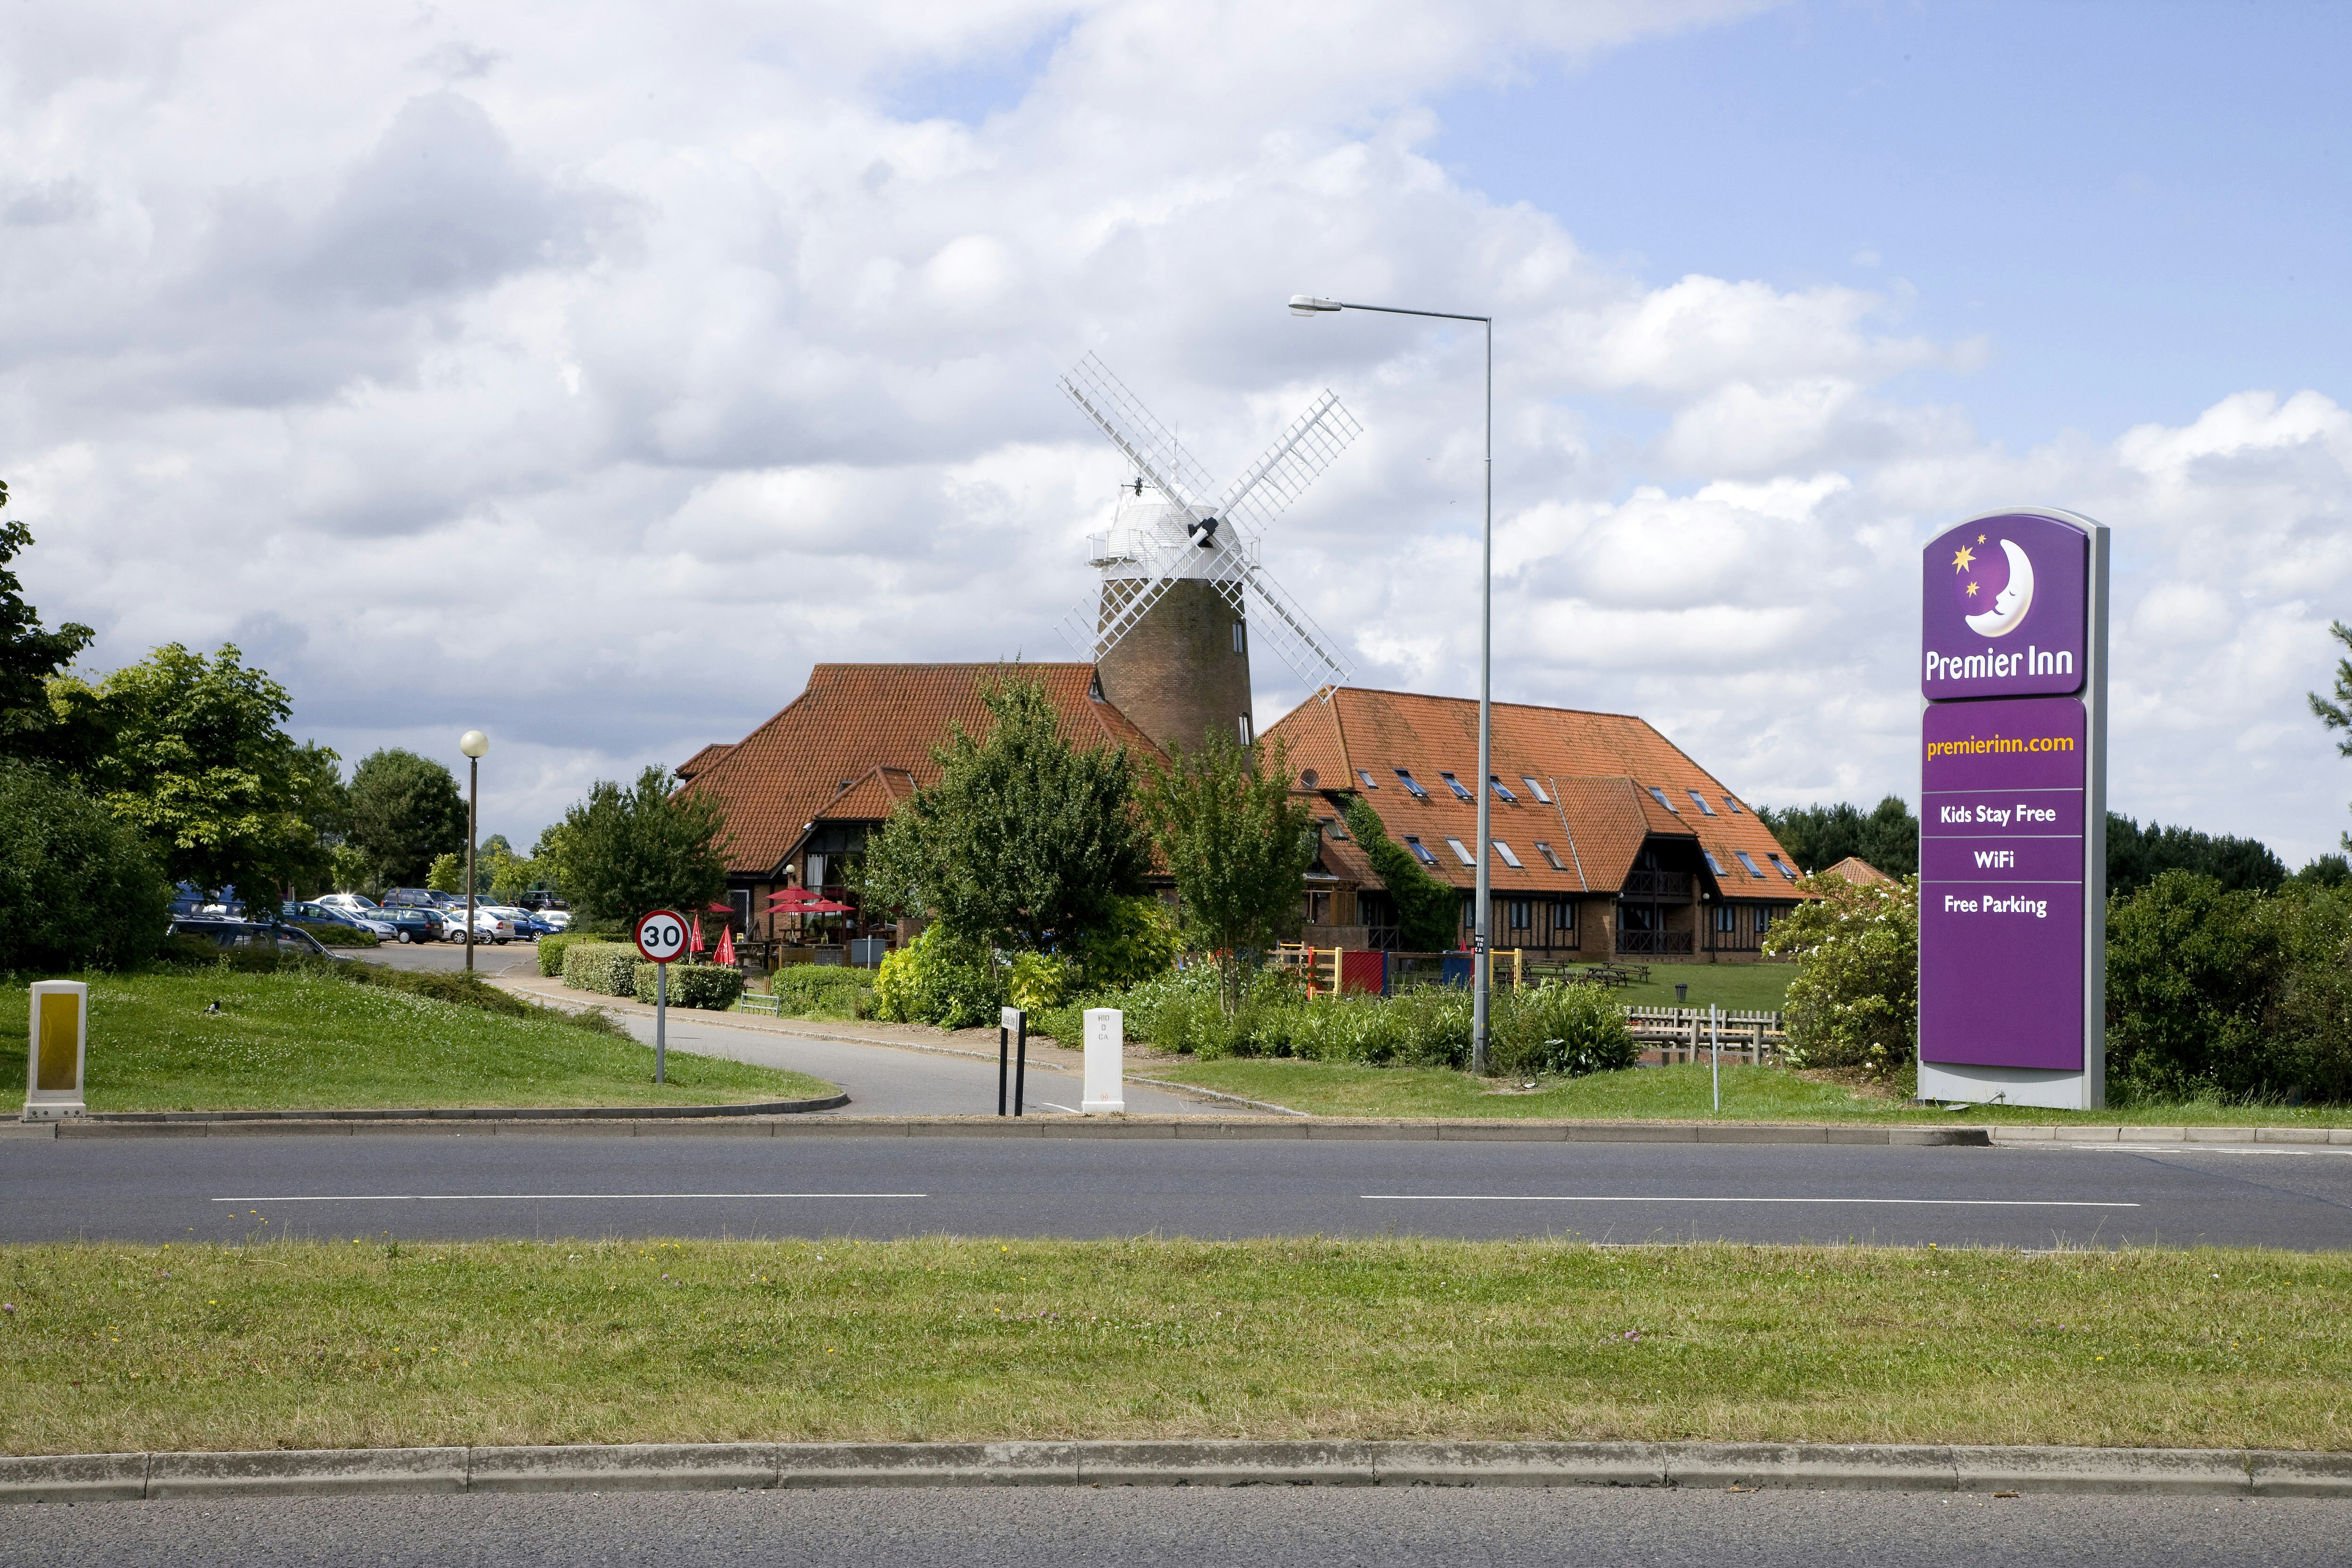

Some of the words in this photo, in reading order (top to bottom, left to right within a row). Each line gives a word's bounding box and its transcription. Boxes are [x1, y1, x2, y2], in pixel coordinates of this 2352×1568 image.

[1926, 647, 2023, 681] Premier
[2029, 645, 2073, 676] Inn
[1927, 734, 2074, 761] premierinn.com
[1940, 806, 1972, 823] Kids
[1976, 805, 2011, 827] Stay
[2016, 804, 2056, 822] Free
[1974, 850, 2014, 868] WiFi
[1945, 895, 1978, 913] Free
[1983, 895, 2047, 918] Parking
[644, 925, 680, 947] 30
